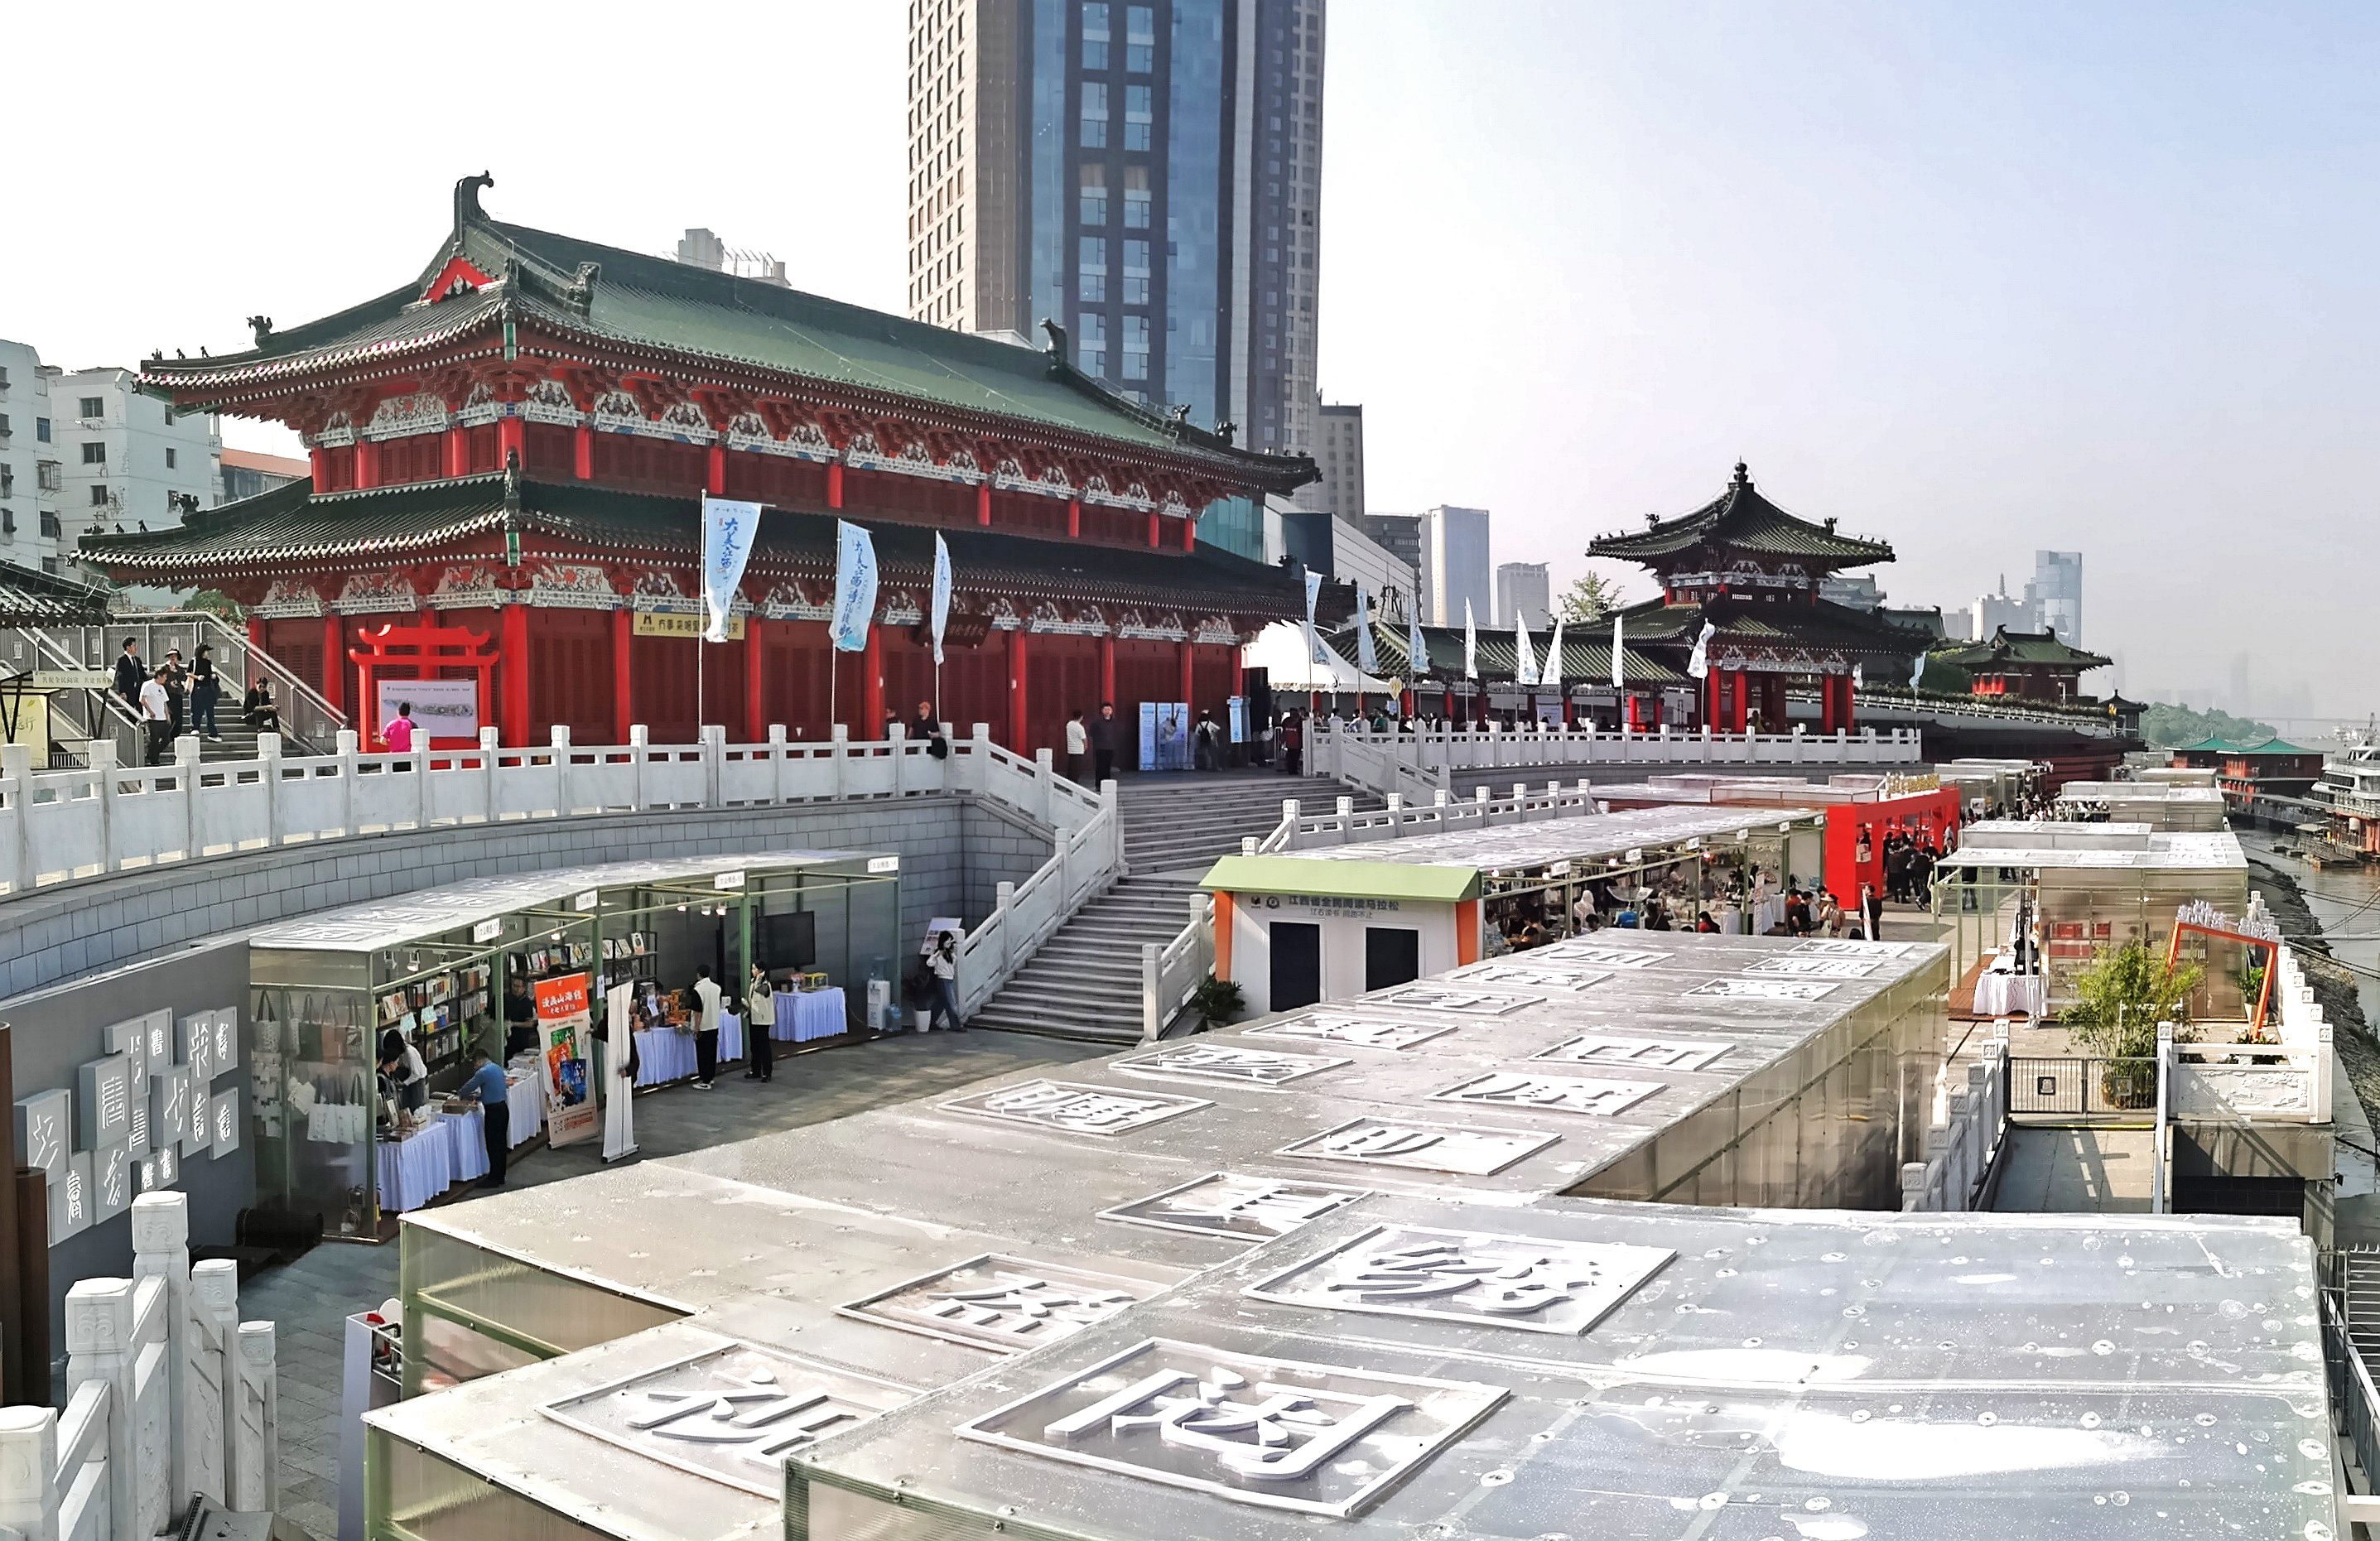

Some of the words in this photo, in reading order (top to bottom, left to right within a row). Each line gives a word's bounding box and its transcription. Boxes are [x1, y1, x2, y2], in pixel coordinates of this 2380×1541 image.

[1289, 895, 1400, 911] 江西省全民阅读马拉松
